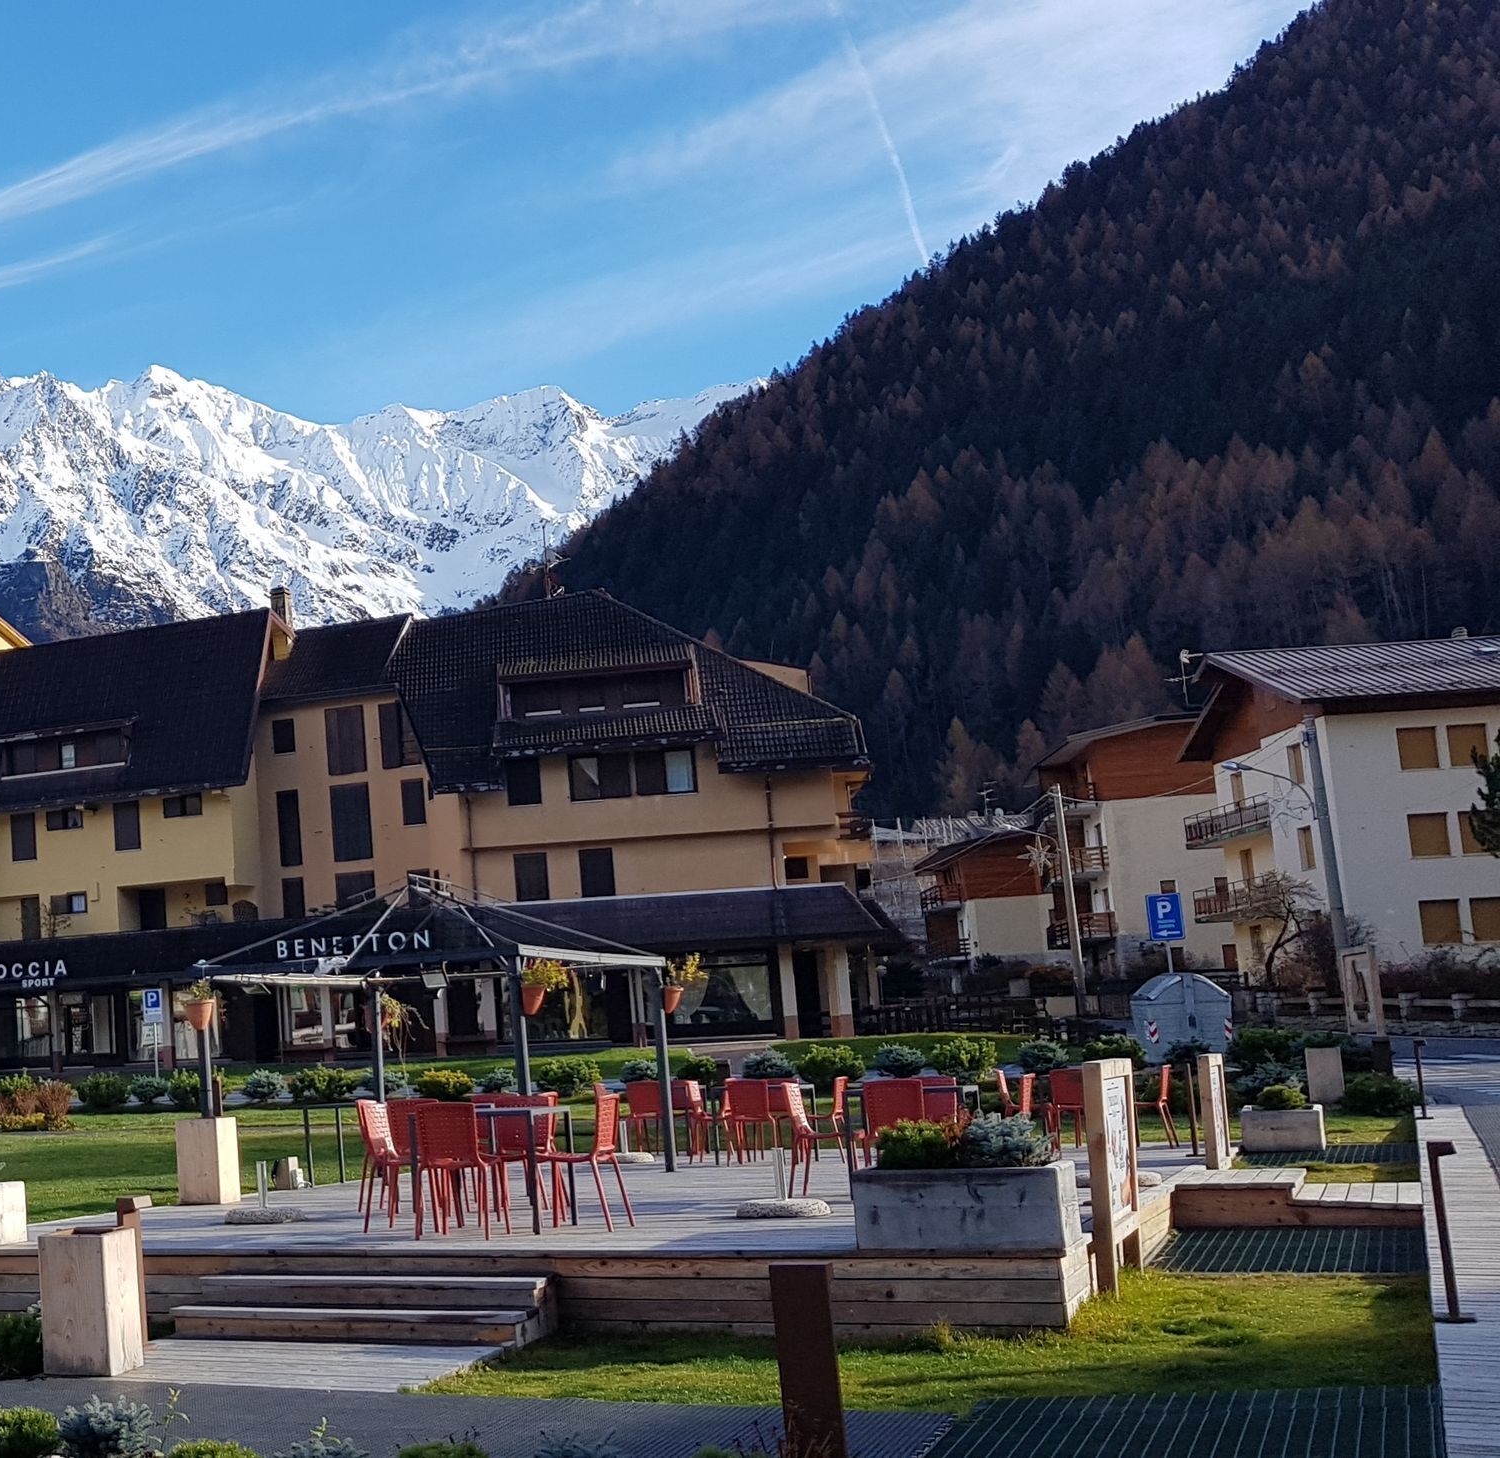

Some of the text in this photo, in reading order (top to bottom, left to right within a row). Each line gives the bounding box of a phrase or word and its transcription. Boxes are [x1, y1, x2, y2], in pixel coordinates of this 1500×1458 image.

[1156, 901, 1171, 919] P
[276, 929, 430, 959] BENETTON
[21, 977, 55, 988] SPORT
[147, 992, 157, 1007] P
